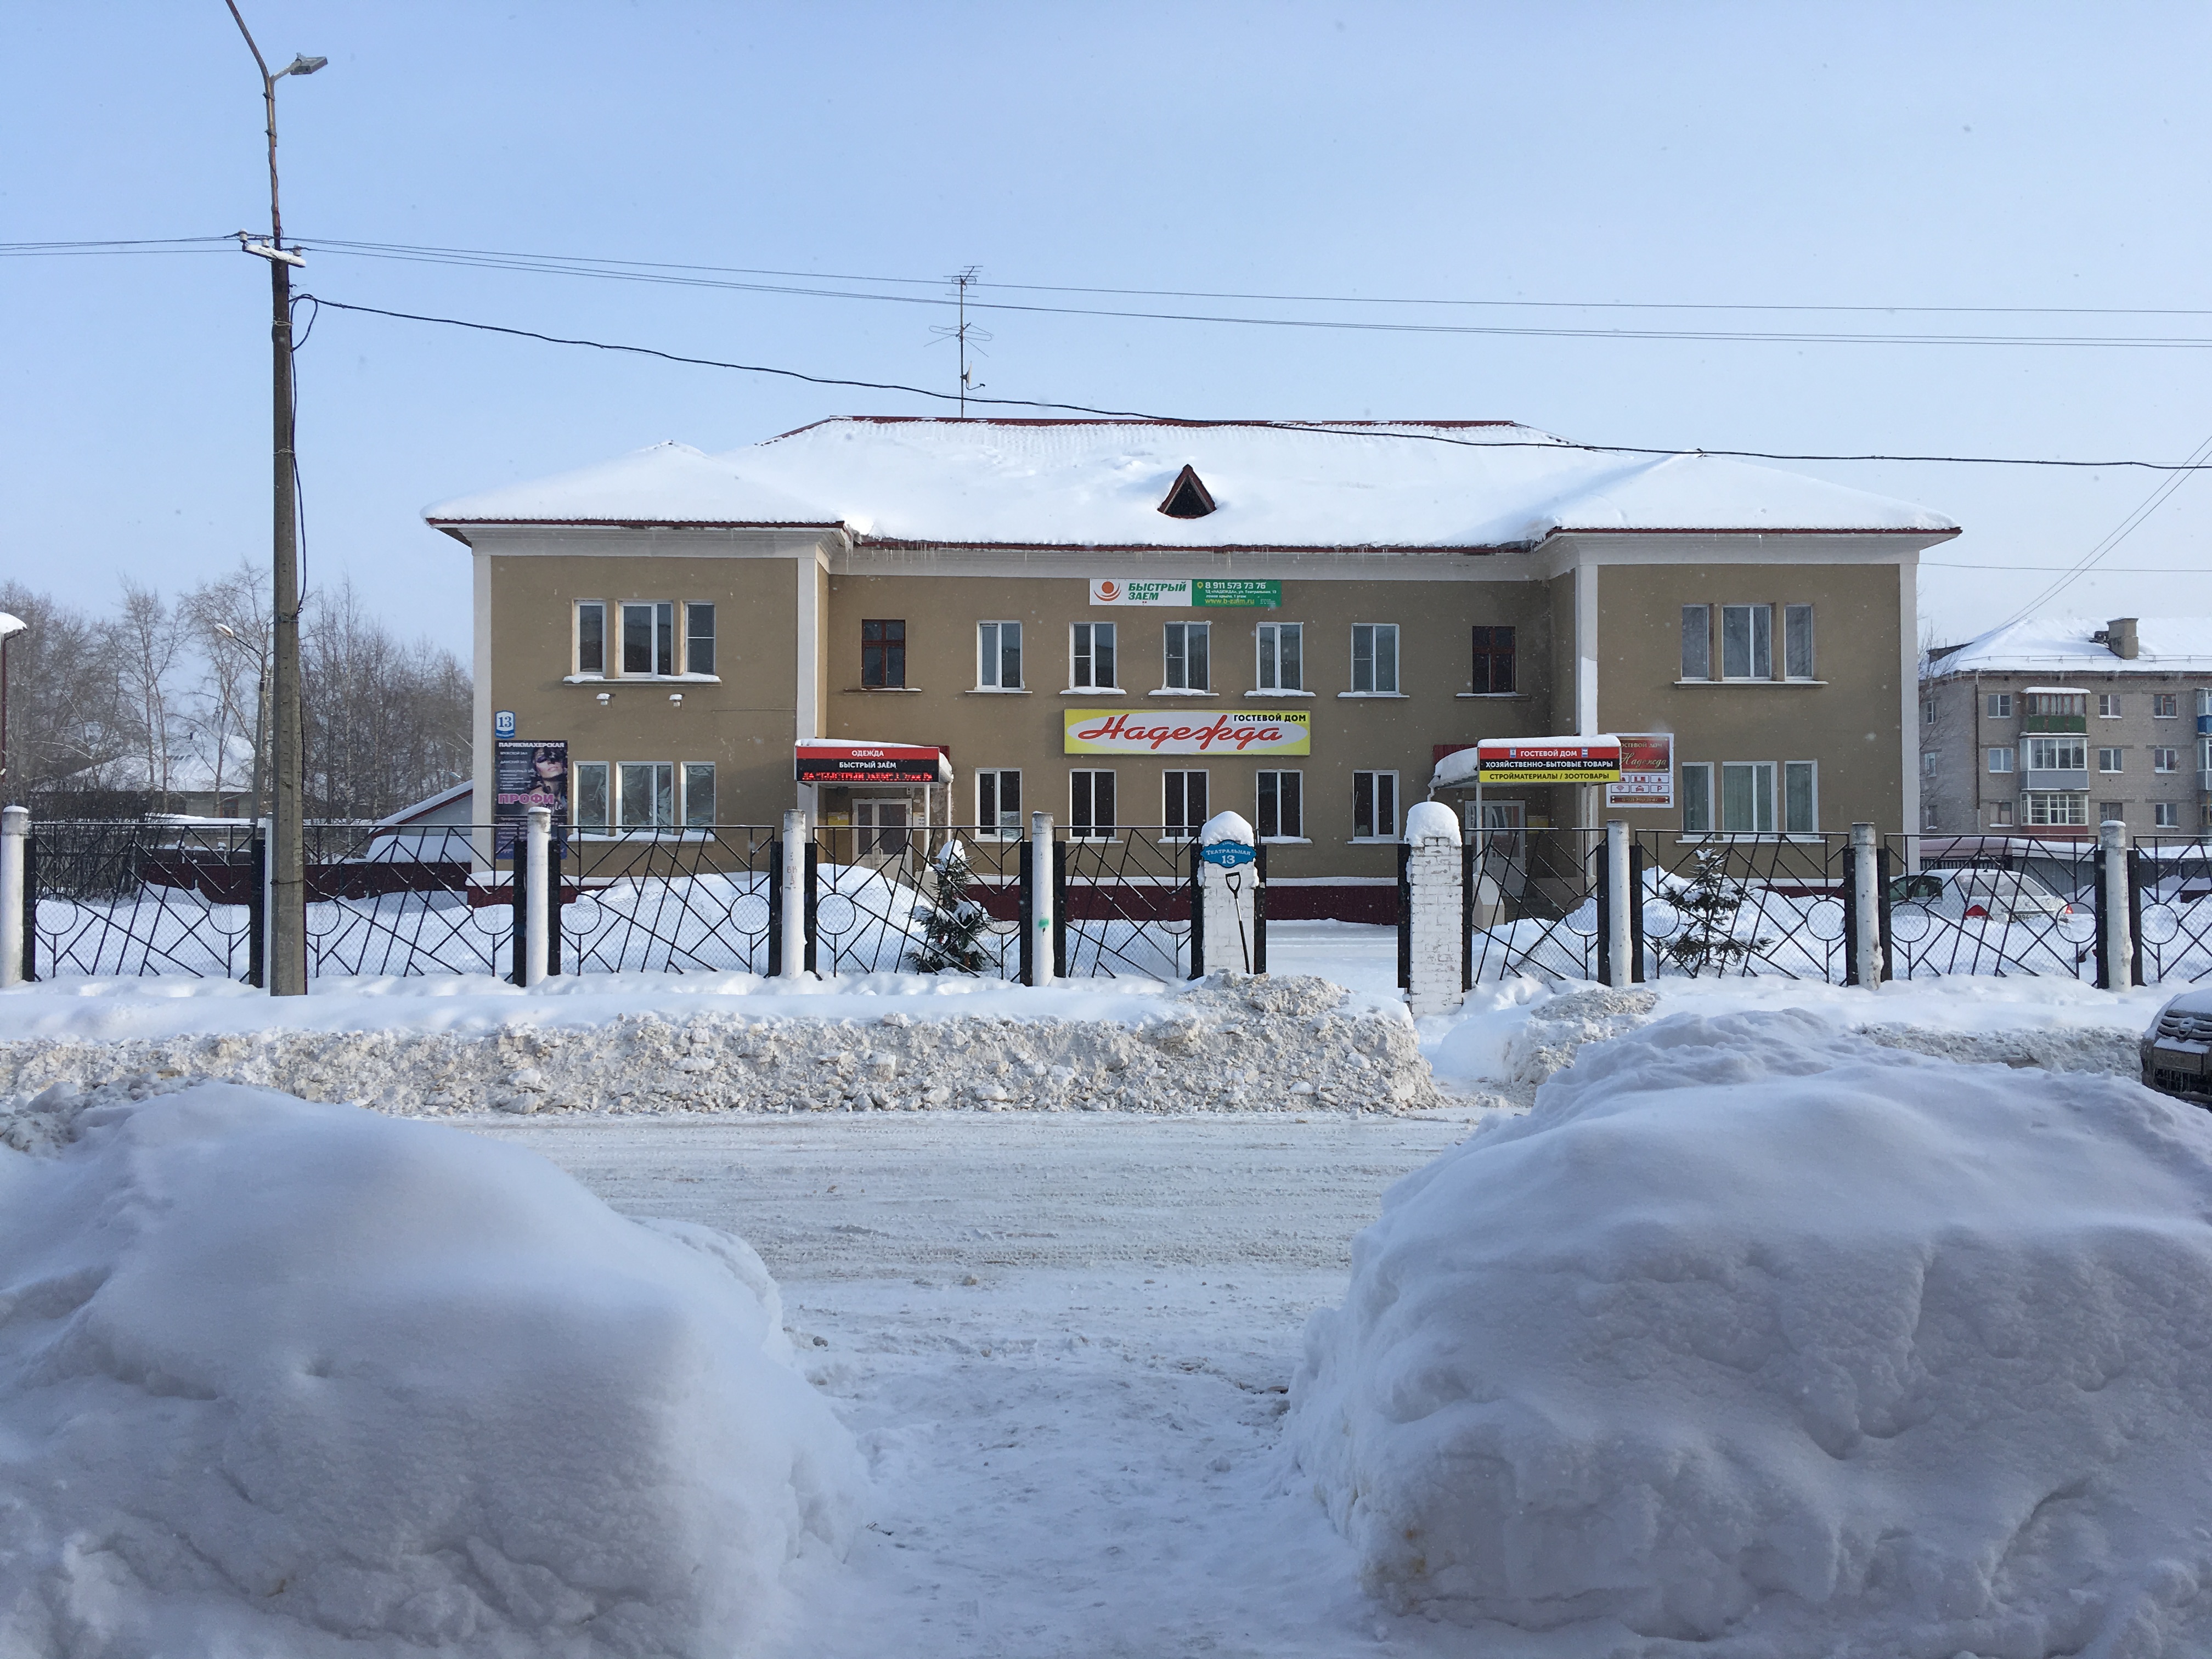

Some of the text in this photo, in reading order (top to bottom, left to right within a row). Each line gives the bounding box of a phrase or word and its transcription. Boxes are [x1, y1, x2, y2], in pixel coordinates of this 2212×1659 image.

[1128, 582, 1187, 591] БЫСТРЫЙ
[1128, 592, 1159, 600] ЗАЕМ
[498, 716, 512, 727] 13
[1234, 713, 1282, 721] ГОСТЕВОЙ
[1078, 714, 1283, 750] Надежда
[1621, 752, 1667, 768] Надежда
[498, 793, 554, 804] ПРОФИ
[1222, 855, 1235, 864] 13
